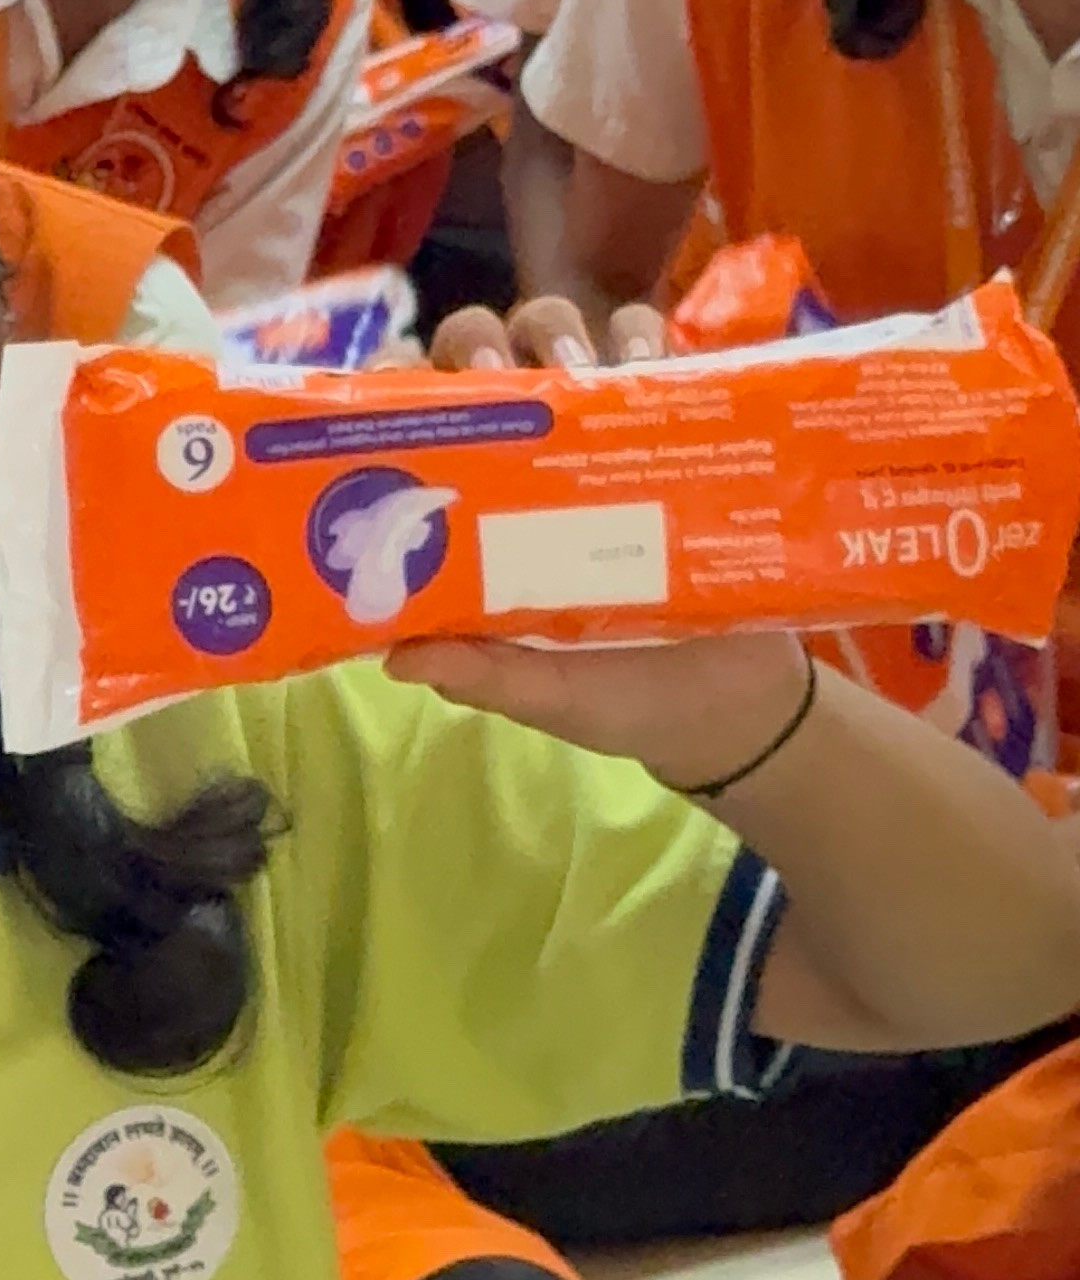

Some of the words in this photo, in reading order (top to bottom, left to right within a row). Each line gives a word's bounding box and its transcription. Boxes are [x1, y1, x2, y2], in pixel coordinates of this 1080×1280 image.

[176, 422, 218, 435] Pads
[183, 437, 215, 482] 6
[178, 583, 237, 620] 26/-
